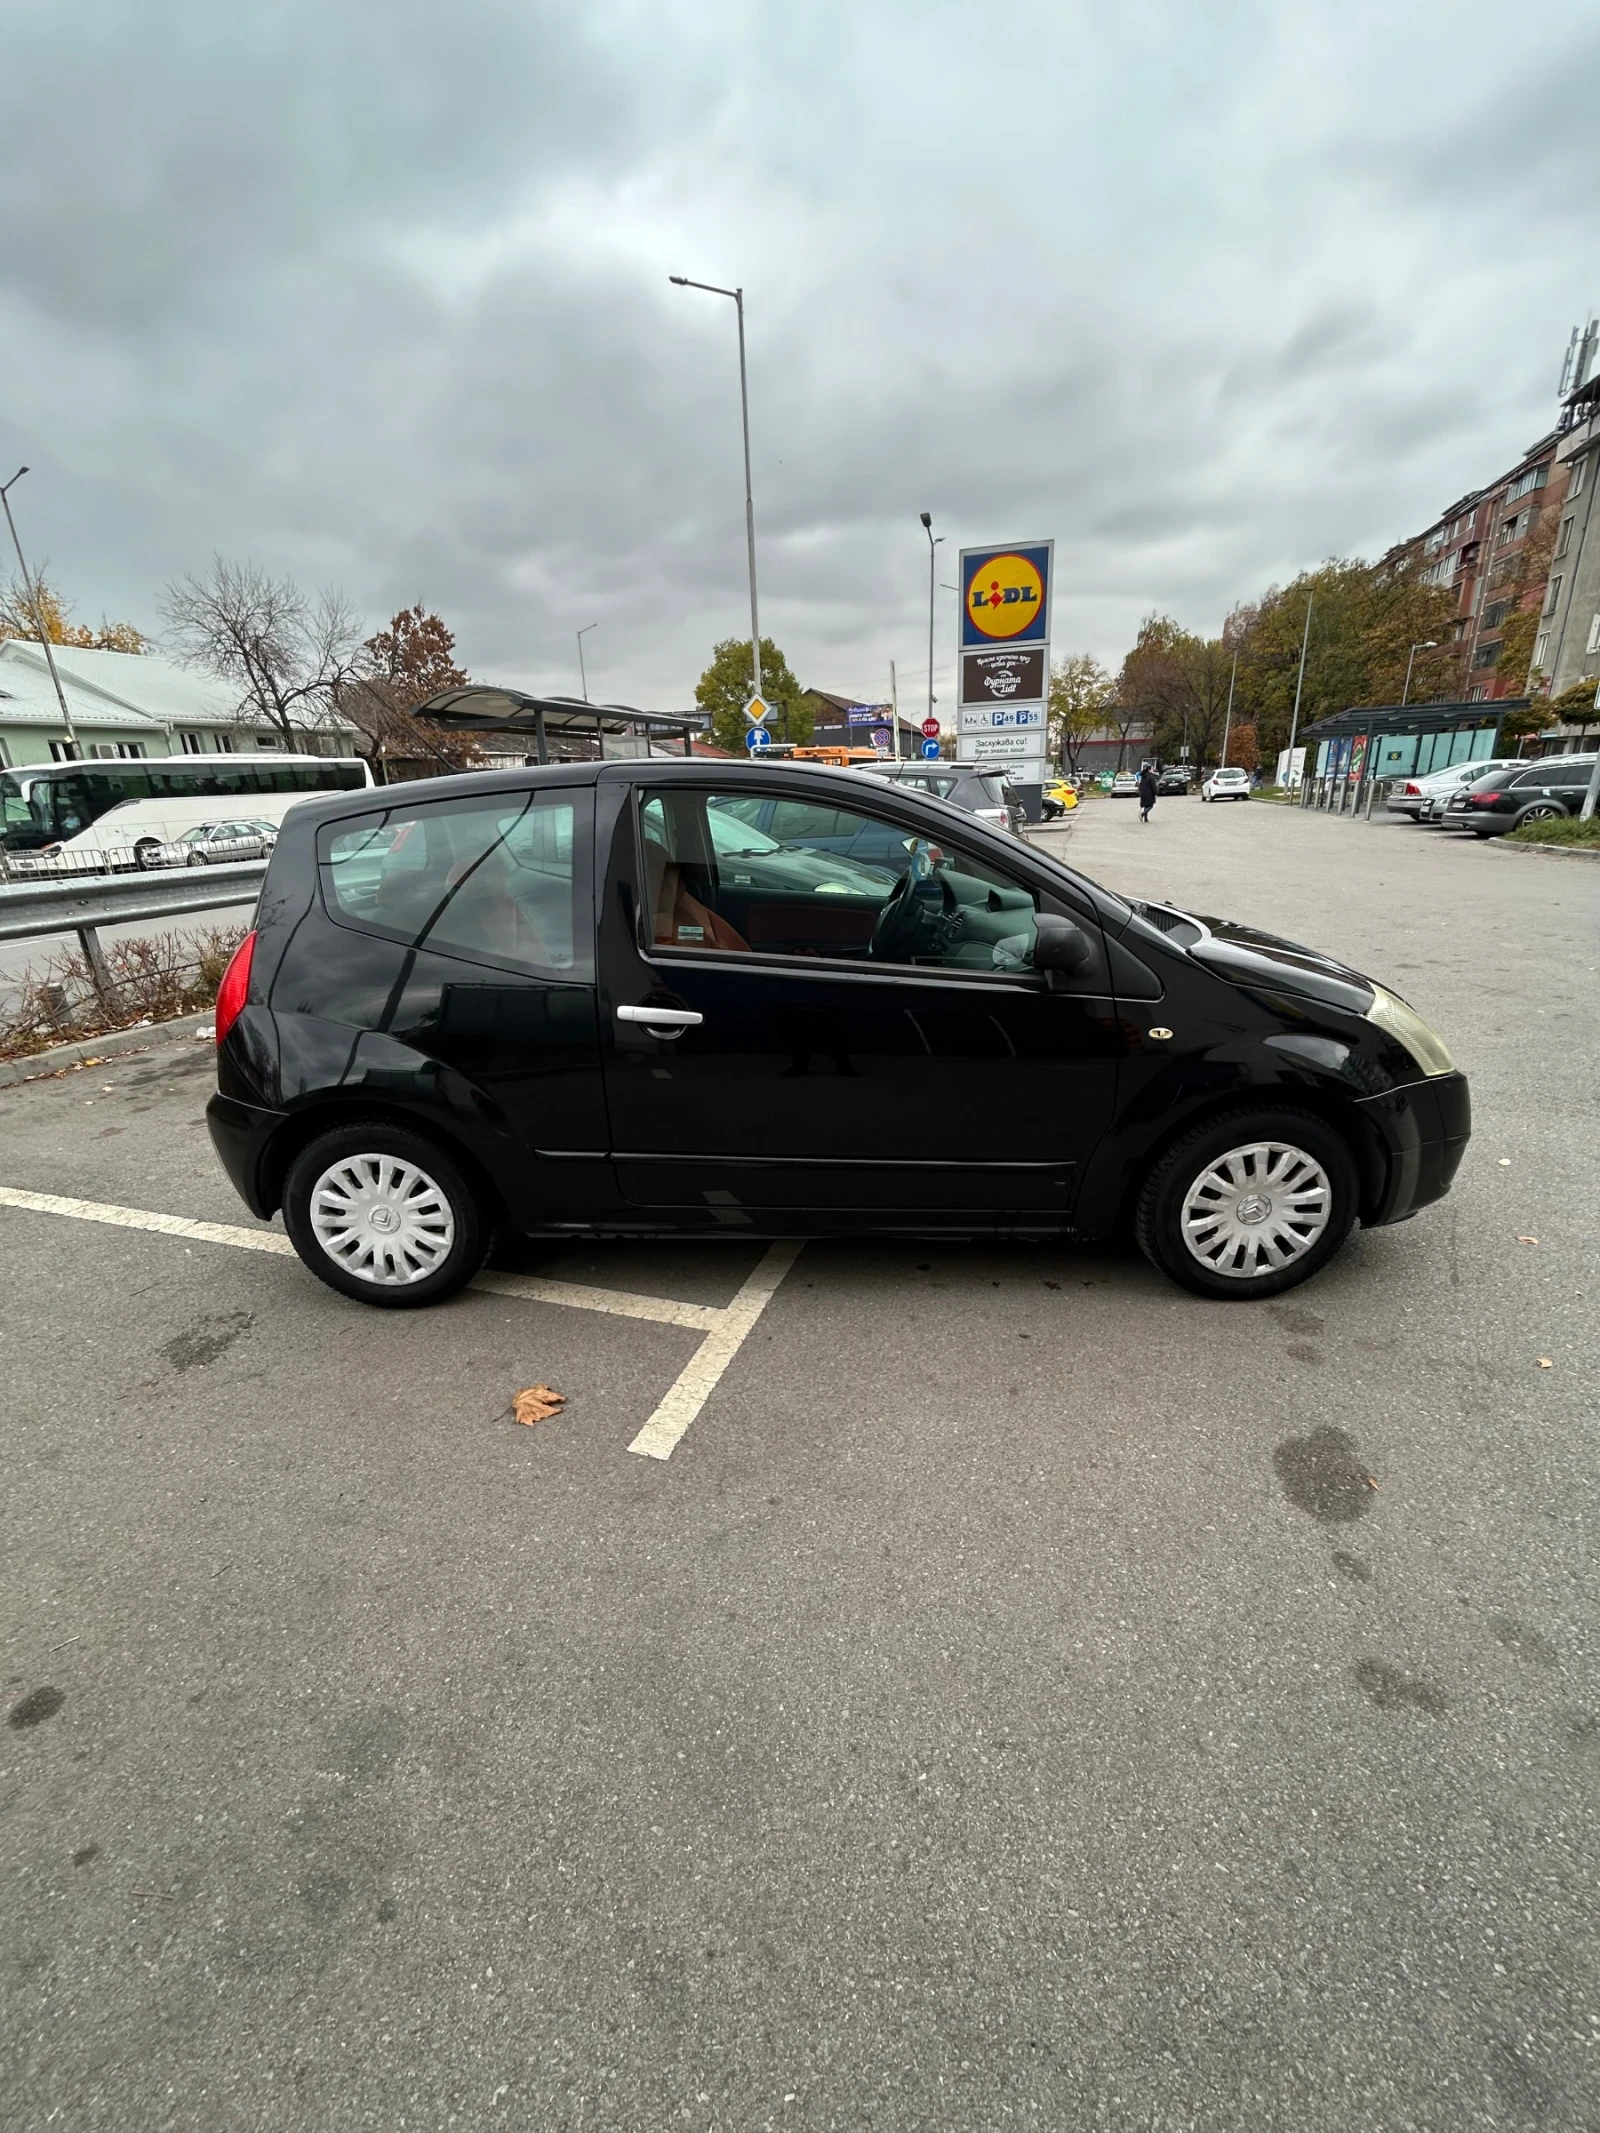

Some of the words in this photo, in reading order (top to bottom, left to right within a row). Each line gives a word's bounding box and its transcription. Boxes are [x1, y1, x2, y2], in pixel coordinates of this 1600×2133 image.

[1000, 684, 1017, 693] Lidl
[1029, 713, 1038, 721] 55
[923, 724, 939, 732] STOP
[975, 738, 1014, 748] Заслужава
[1015, 737, 1027, 745] си!
